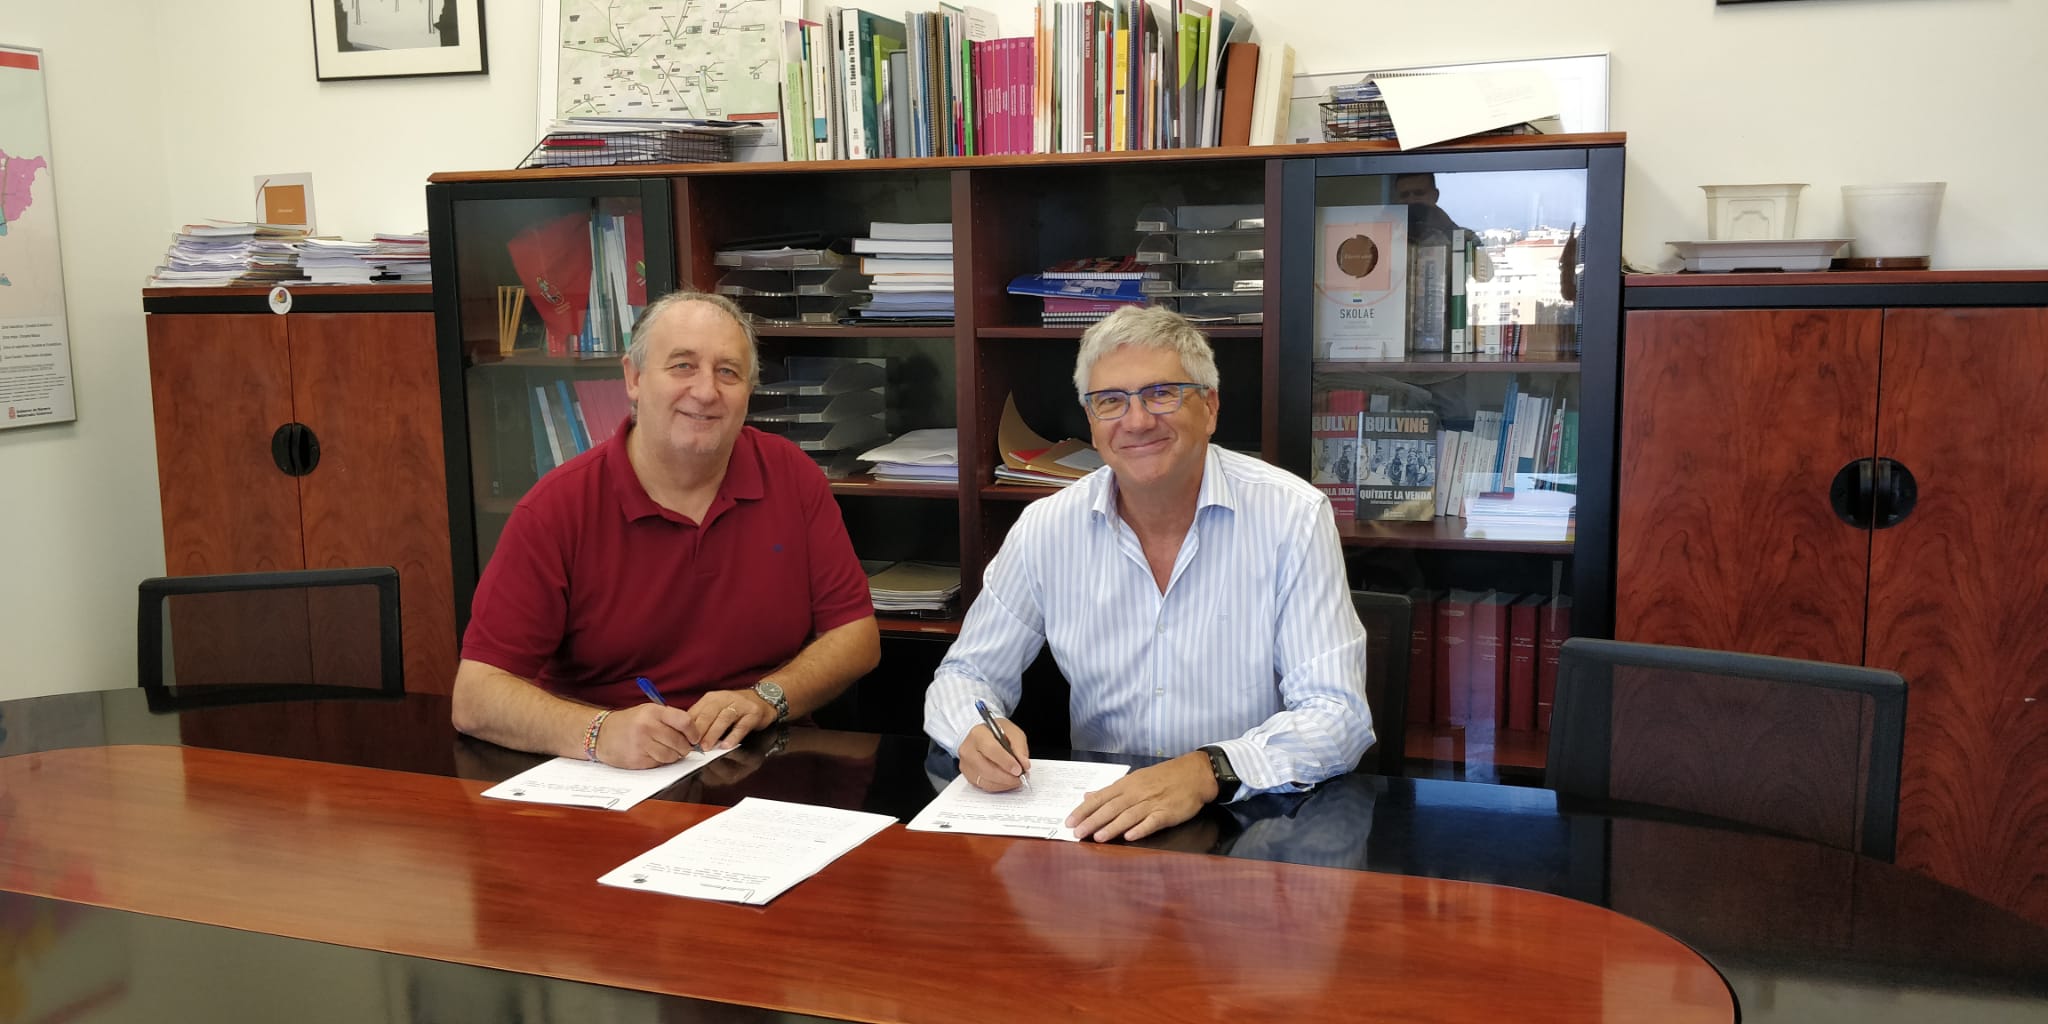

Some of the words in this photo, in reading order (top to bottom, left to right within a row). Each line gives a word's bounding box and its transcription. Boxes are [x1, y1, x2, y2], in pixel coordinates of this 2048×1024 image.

[1340, 308, 1375, 319] SKOLAE
[1312, 415, 1358, 431] BULLYI
[1365, 416, 1429, 433] BULLYING
[1360, 489, 1392, 500] QUÍTATE
[1394, 490, 1403, 500] LA
[1405, 490, 1432, 500] VENDA
